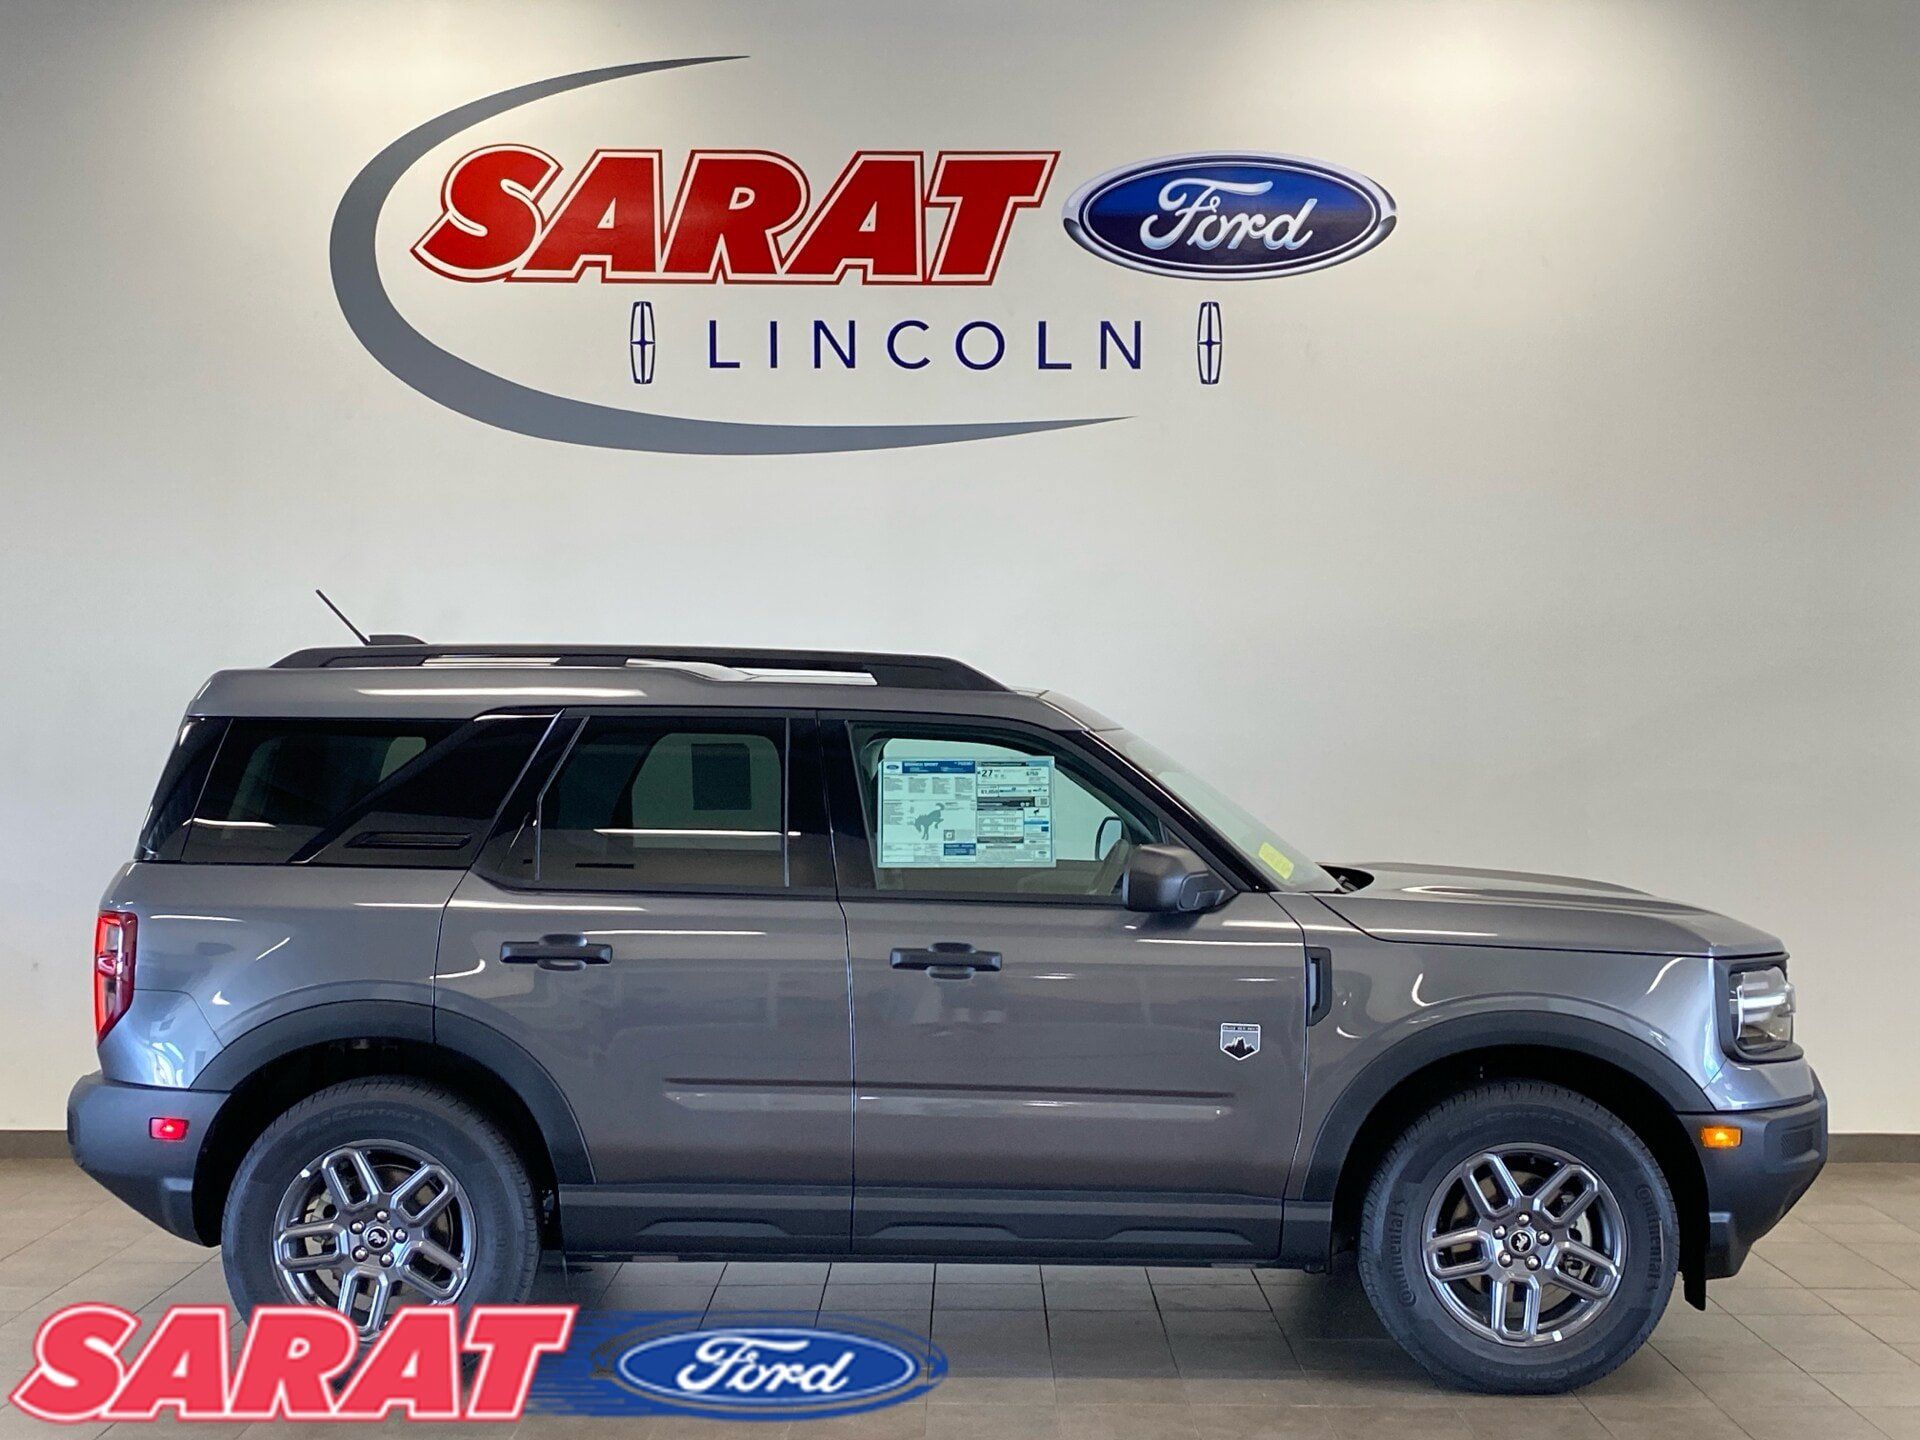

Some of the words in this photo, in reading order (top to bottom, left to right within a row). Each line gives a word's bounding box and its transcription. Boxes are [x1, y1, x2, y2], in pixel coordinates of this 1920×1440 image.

[411, 144, 1058, 284] SARAT
[1139, 177, 1314, 251] Ford
[709, 320, 1142, 369] LINCOLN
